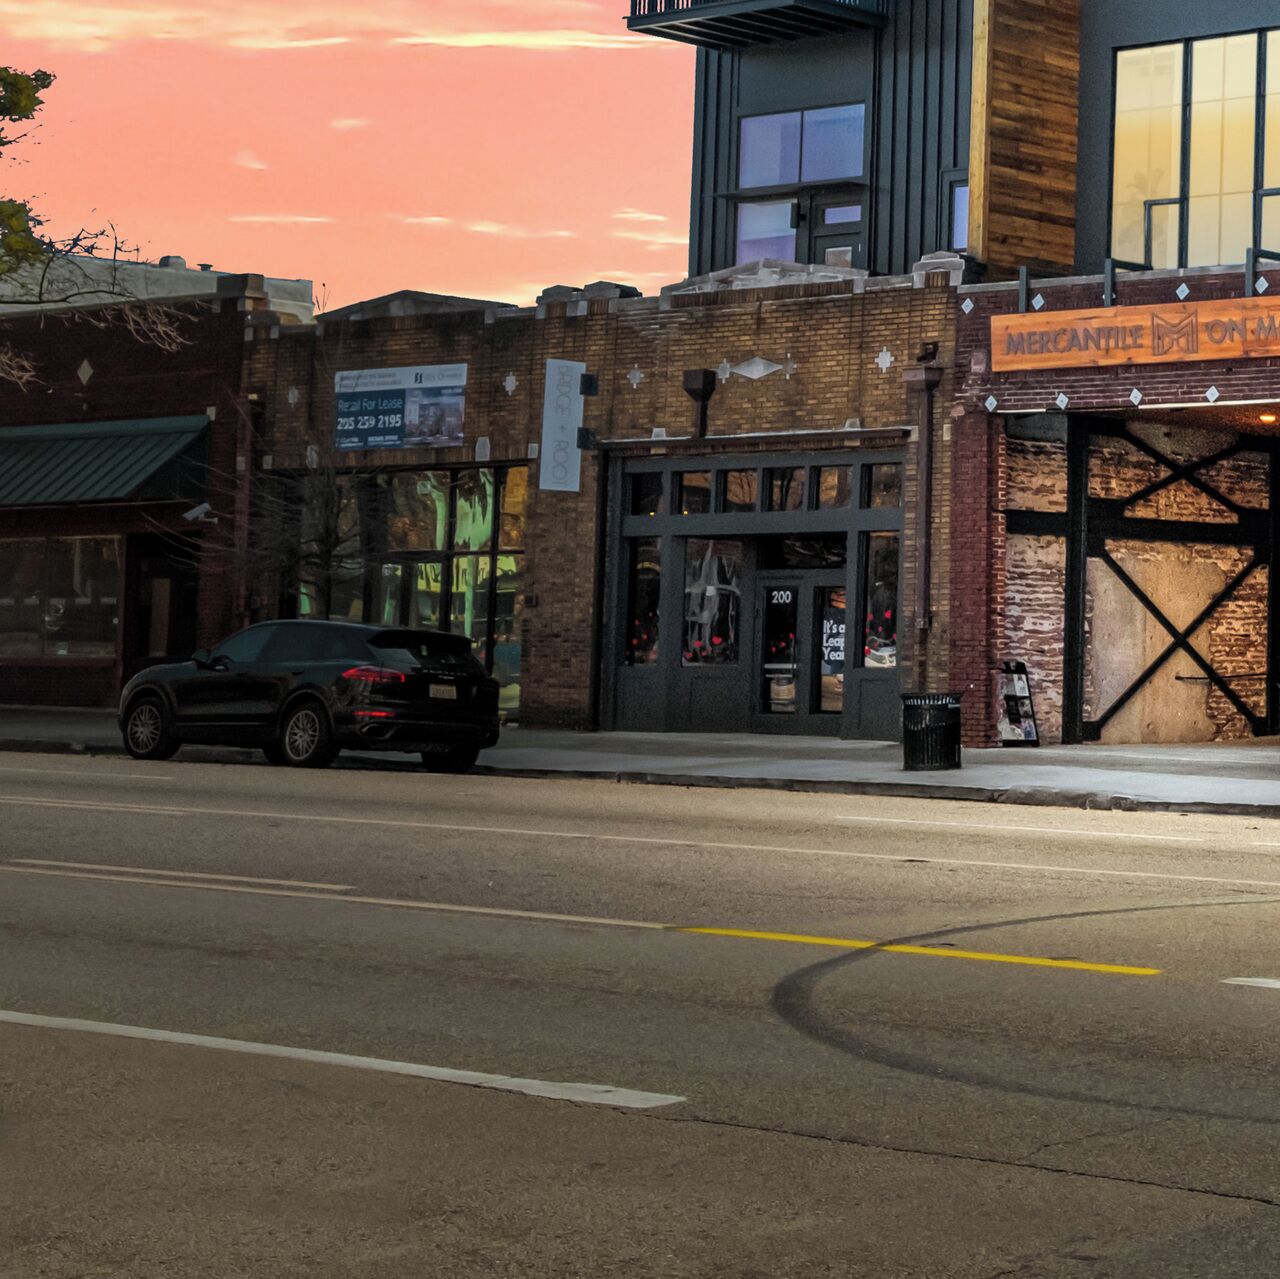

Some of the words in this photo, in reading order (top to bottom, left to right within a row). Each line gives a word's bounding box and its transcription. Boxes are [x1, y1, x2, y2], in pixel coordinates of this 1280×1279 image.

[1004, 324, 1144, 357] MERCANTILE
[1205, 316, 1246, 344] ON
[362, 398, 377, 410] For
[378, 398, 402, 409] Lease
[357, 416, 375, 429] 259
[378, 414, 402, 428] 2195
[772, 591, 792, 603] 200
